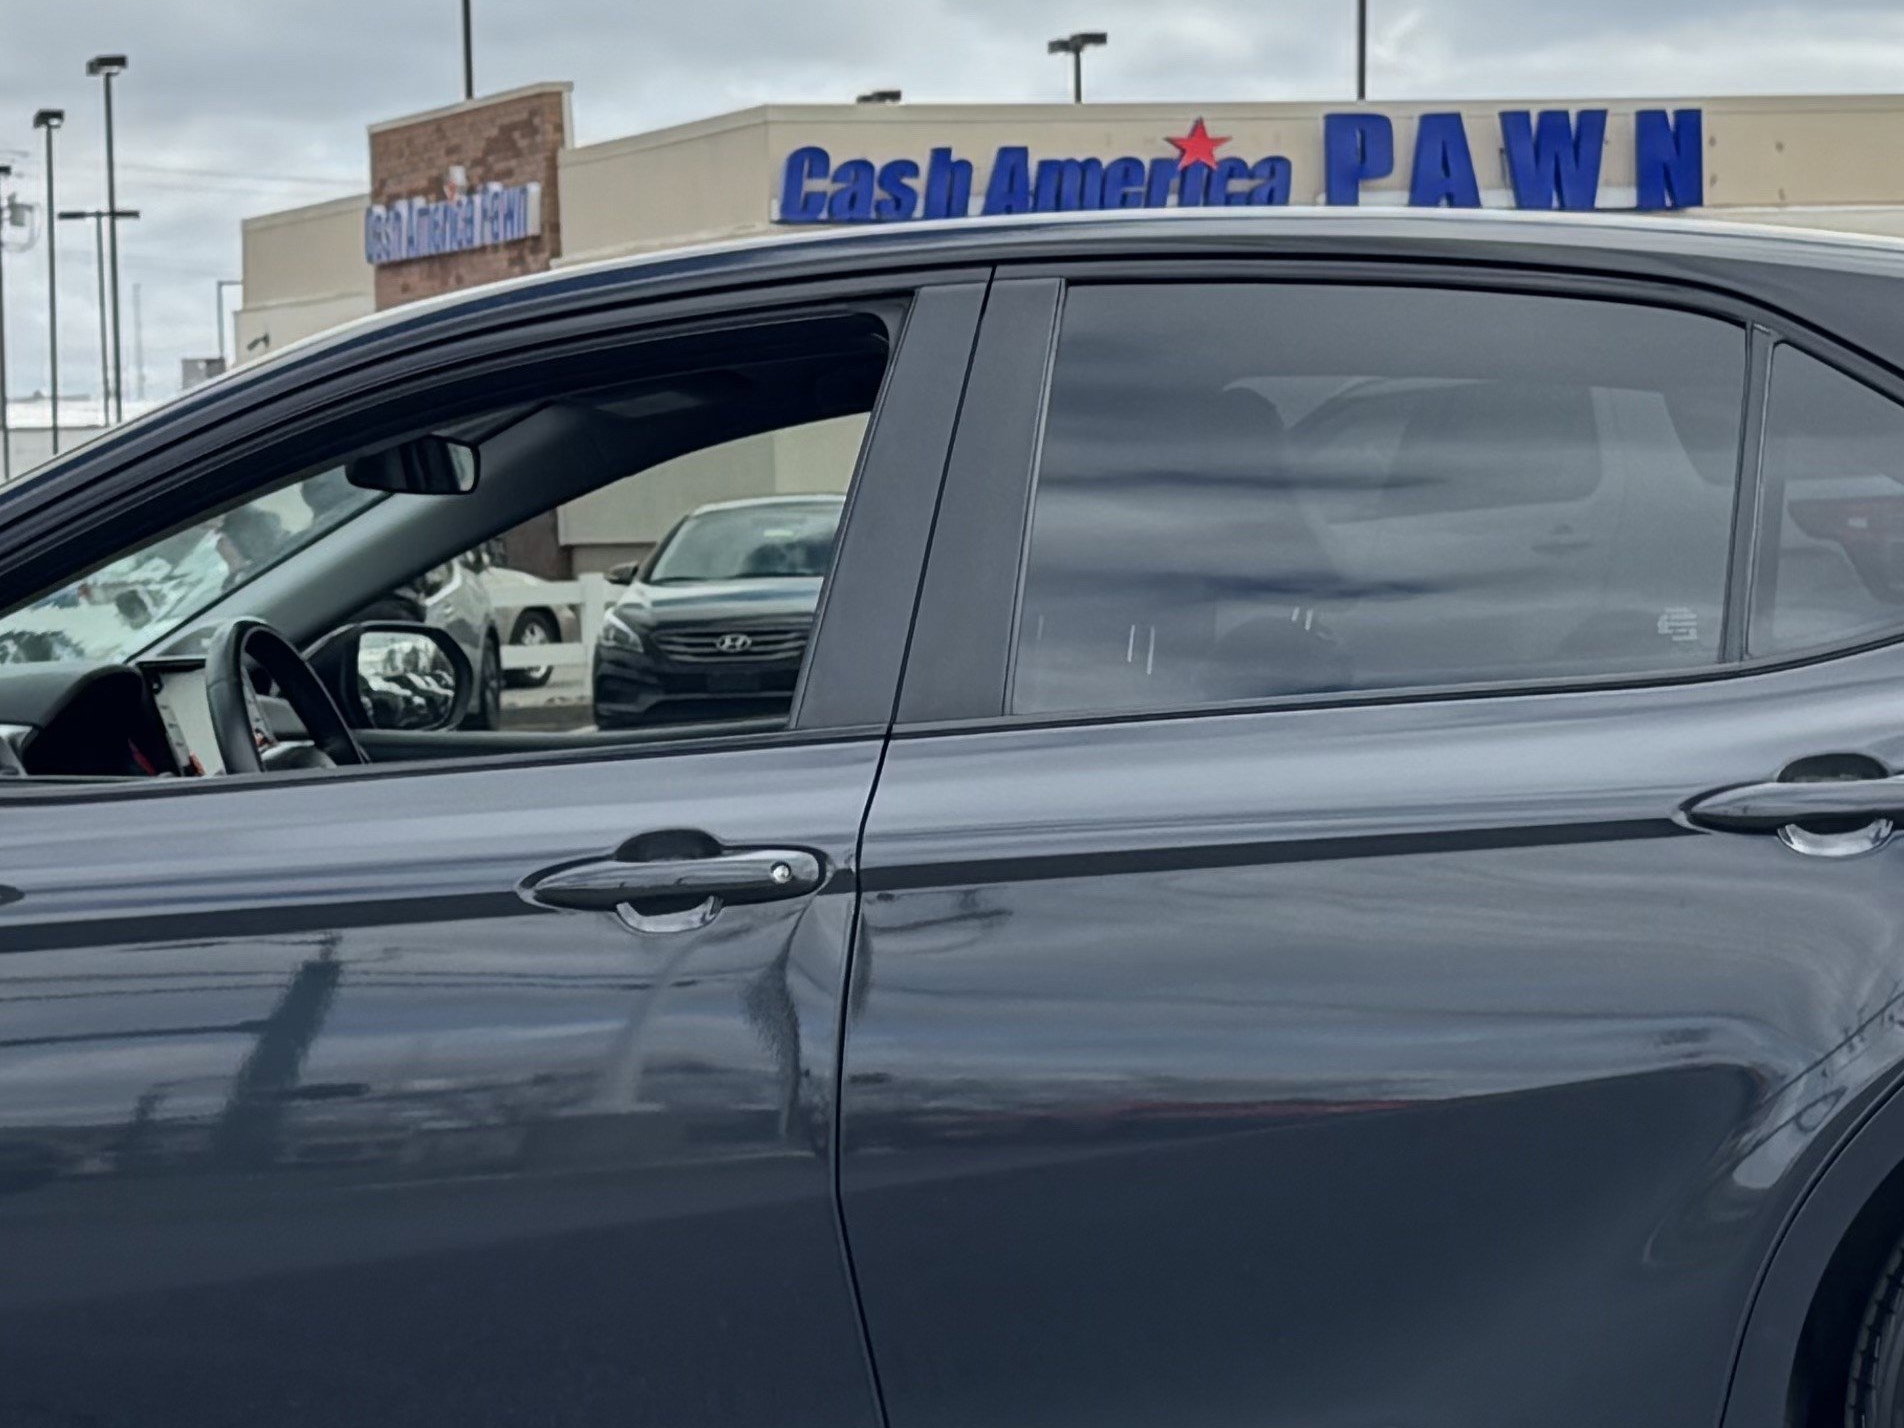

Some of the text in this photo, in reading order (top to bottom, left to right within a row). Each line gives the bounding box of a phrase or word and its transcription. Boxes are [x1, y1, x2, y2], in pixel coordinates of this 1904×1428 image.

[781, 109, 1704, 223] Cash America PAWN
